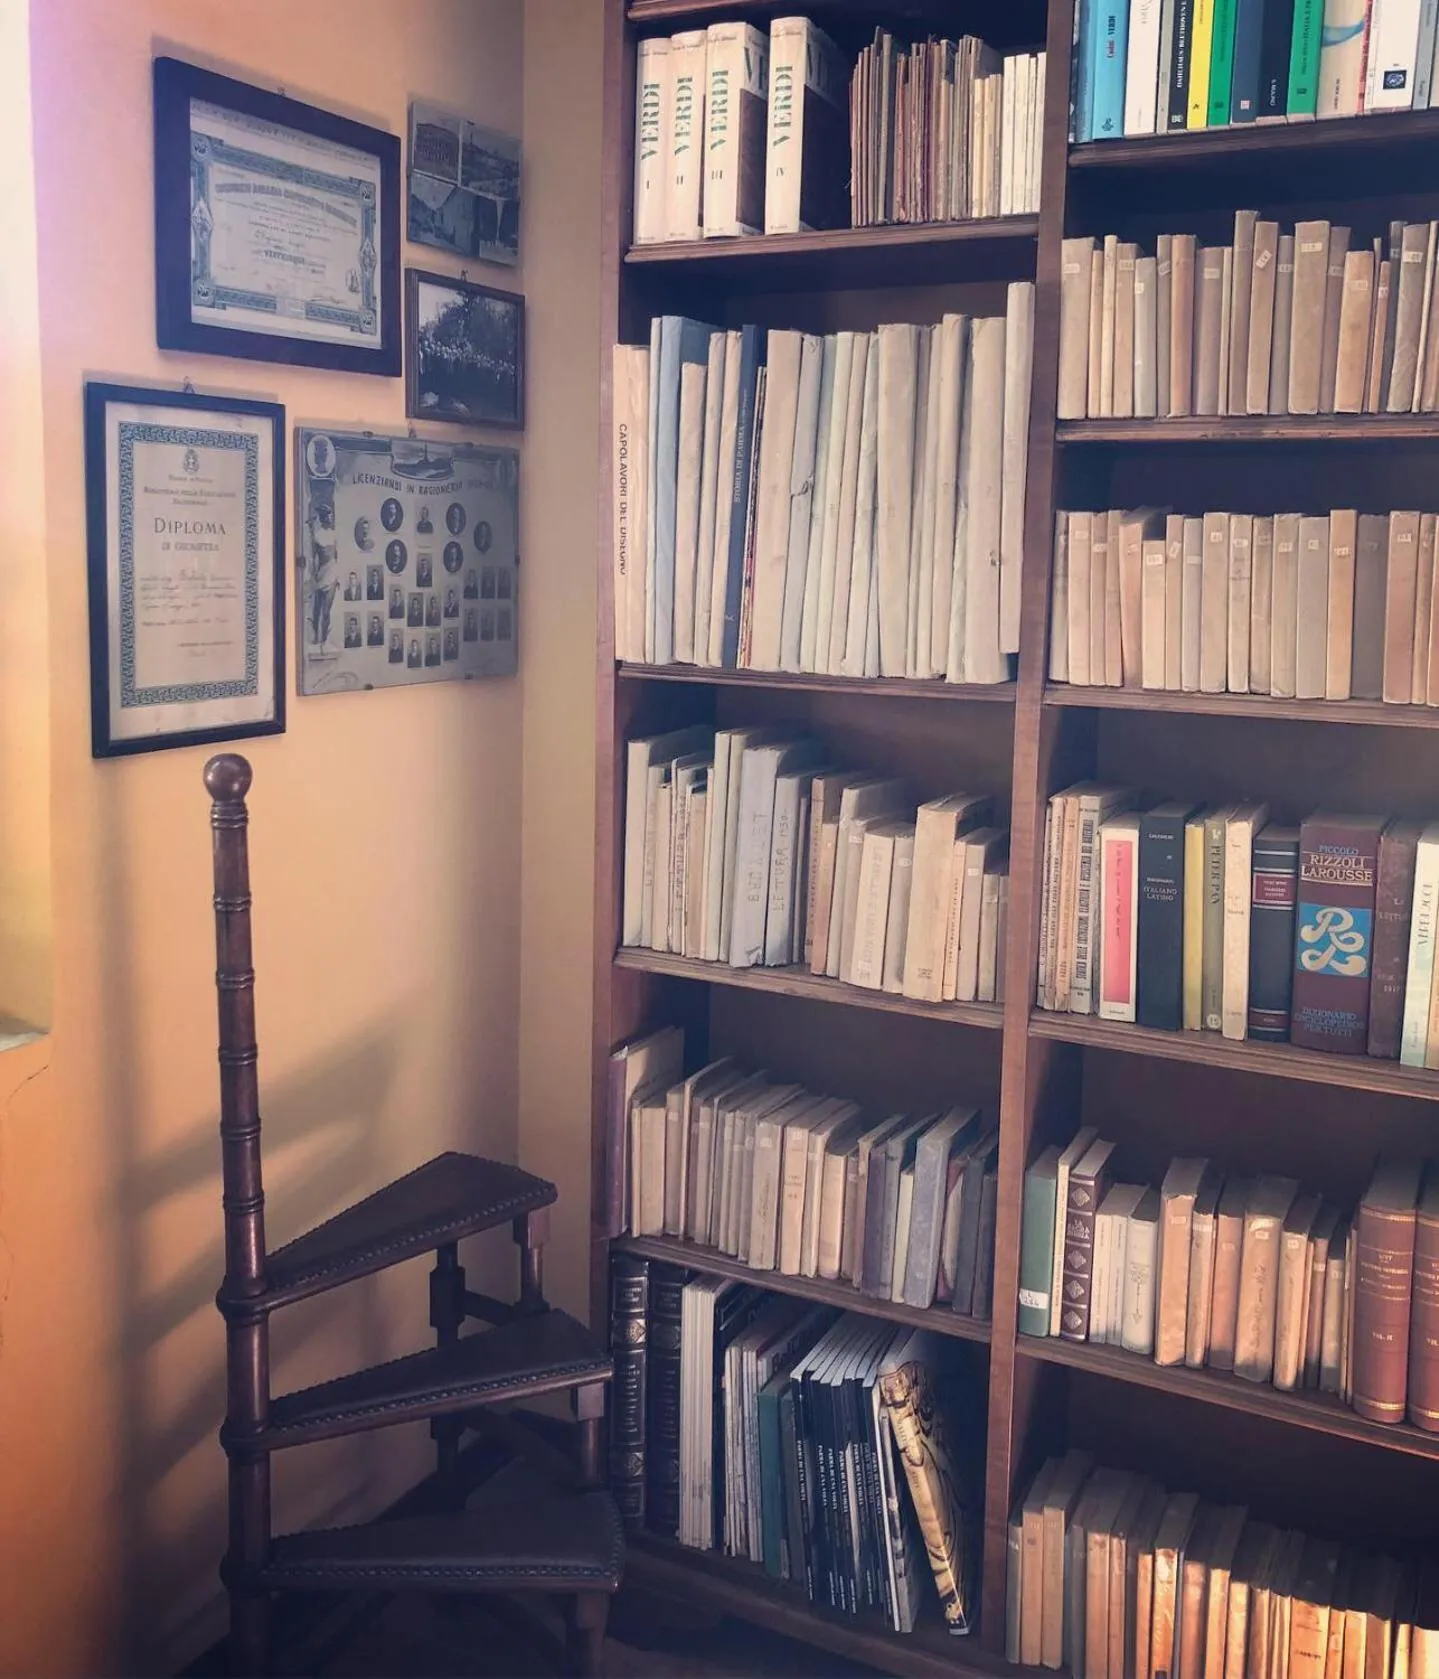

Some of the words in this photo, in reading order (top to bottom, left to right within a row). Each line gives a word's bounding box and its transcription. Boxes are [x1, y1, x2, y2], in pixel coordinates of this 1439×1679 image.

[641, 84, 660, 160] VERDI
[674, 77, 693, 156] VERDI
[710, 70, 729, 150] VERDI
[772, 66, 793, 147] VERDI
[737, 425, 746, 457] PARMA
[619, 423, 628, 496] CAPOLAVORI
[352, 472, 402, 492] LICENZIANDI
[406, 483, 415, 494] IN
[734, 471, 744, 503] STORIA
[154, 517, 227, 535] DIPLOMA
[619, 502, 628, 522] DEL
[1310, 854, 1366, 869] RIZZOLI
[1319, 845, 1359, 856] PICCOLO
[1301, 866, 1373, 881] LAROUSSE
